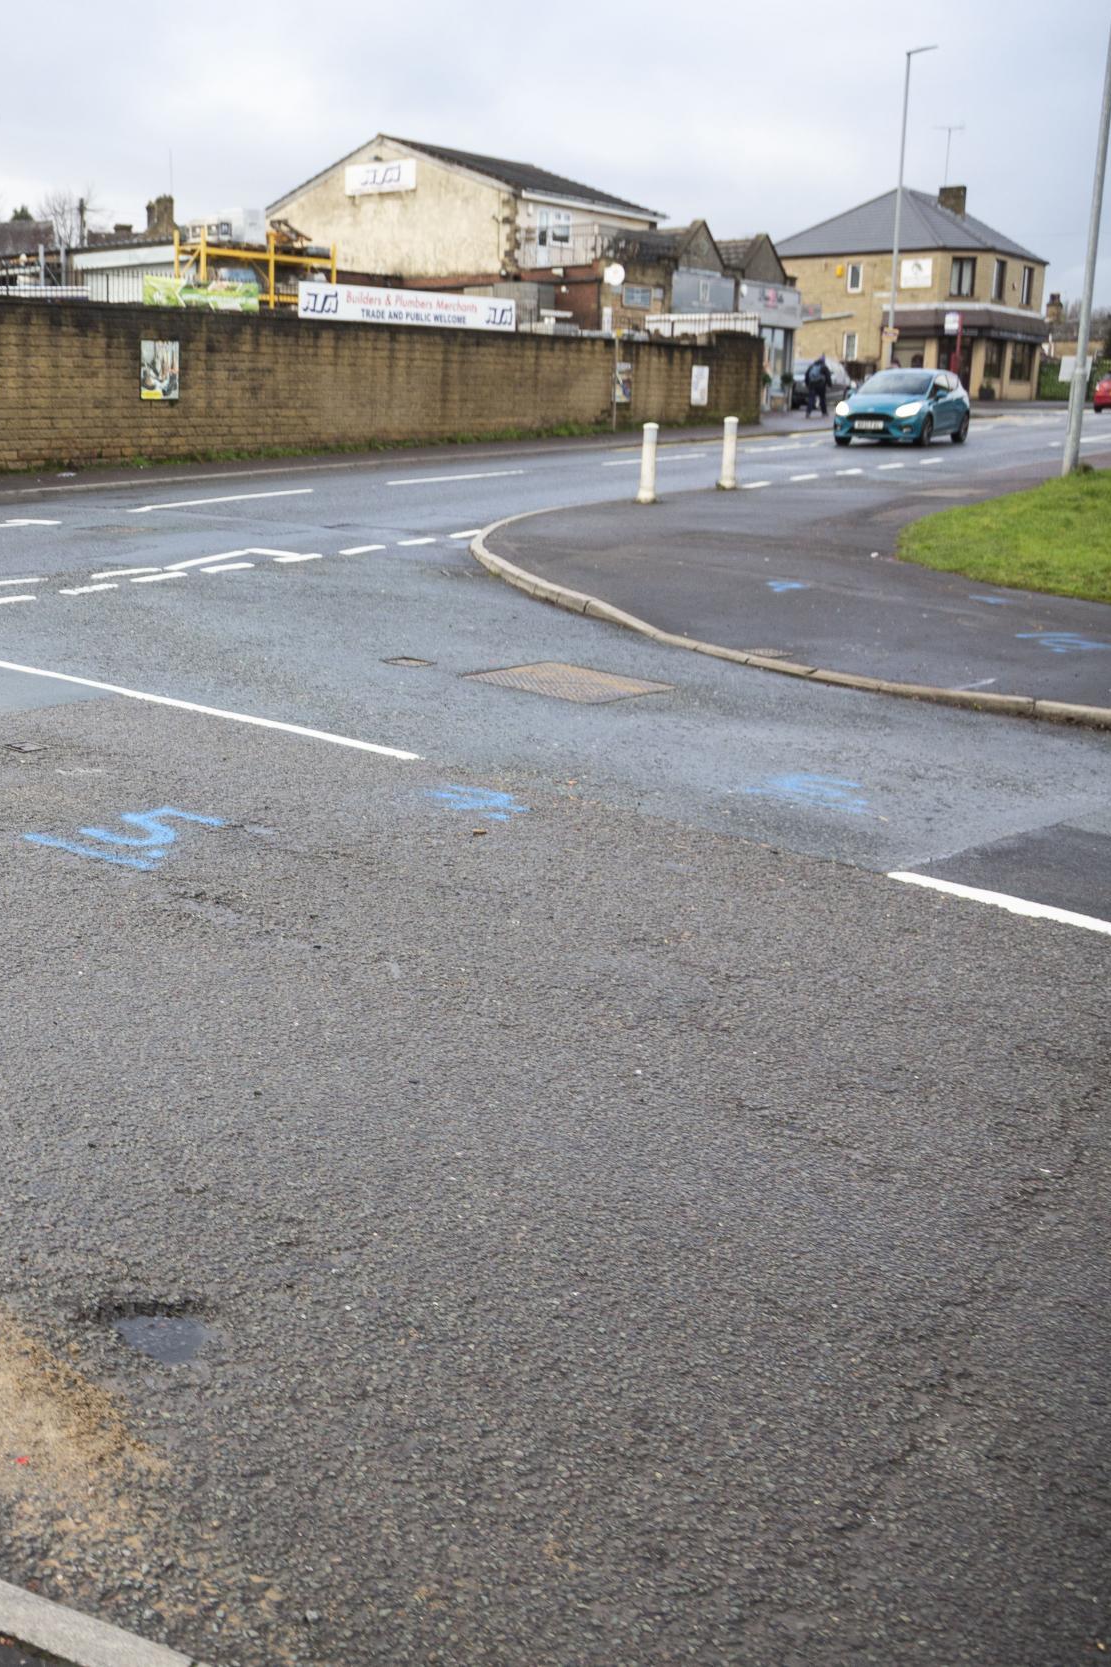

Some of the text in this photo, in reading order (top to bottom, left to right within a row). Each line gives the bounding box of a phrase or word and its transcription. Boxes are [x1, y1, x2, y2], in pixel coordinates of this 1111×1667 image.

[345, 291, 478, 314] Builders & Plumbers Merchants
[361, 308, 467, 325] TRADE AND PUBLIC WELCOME
